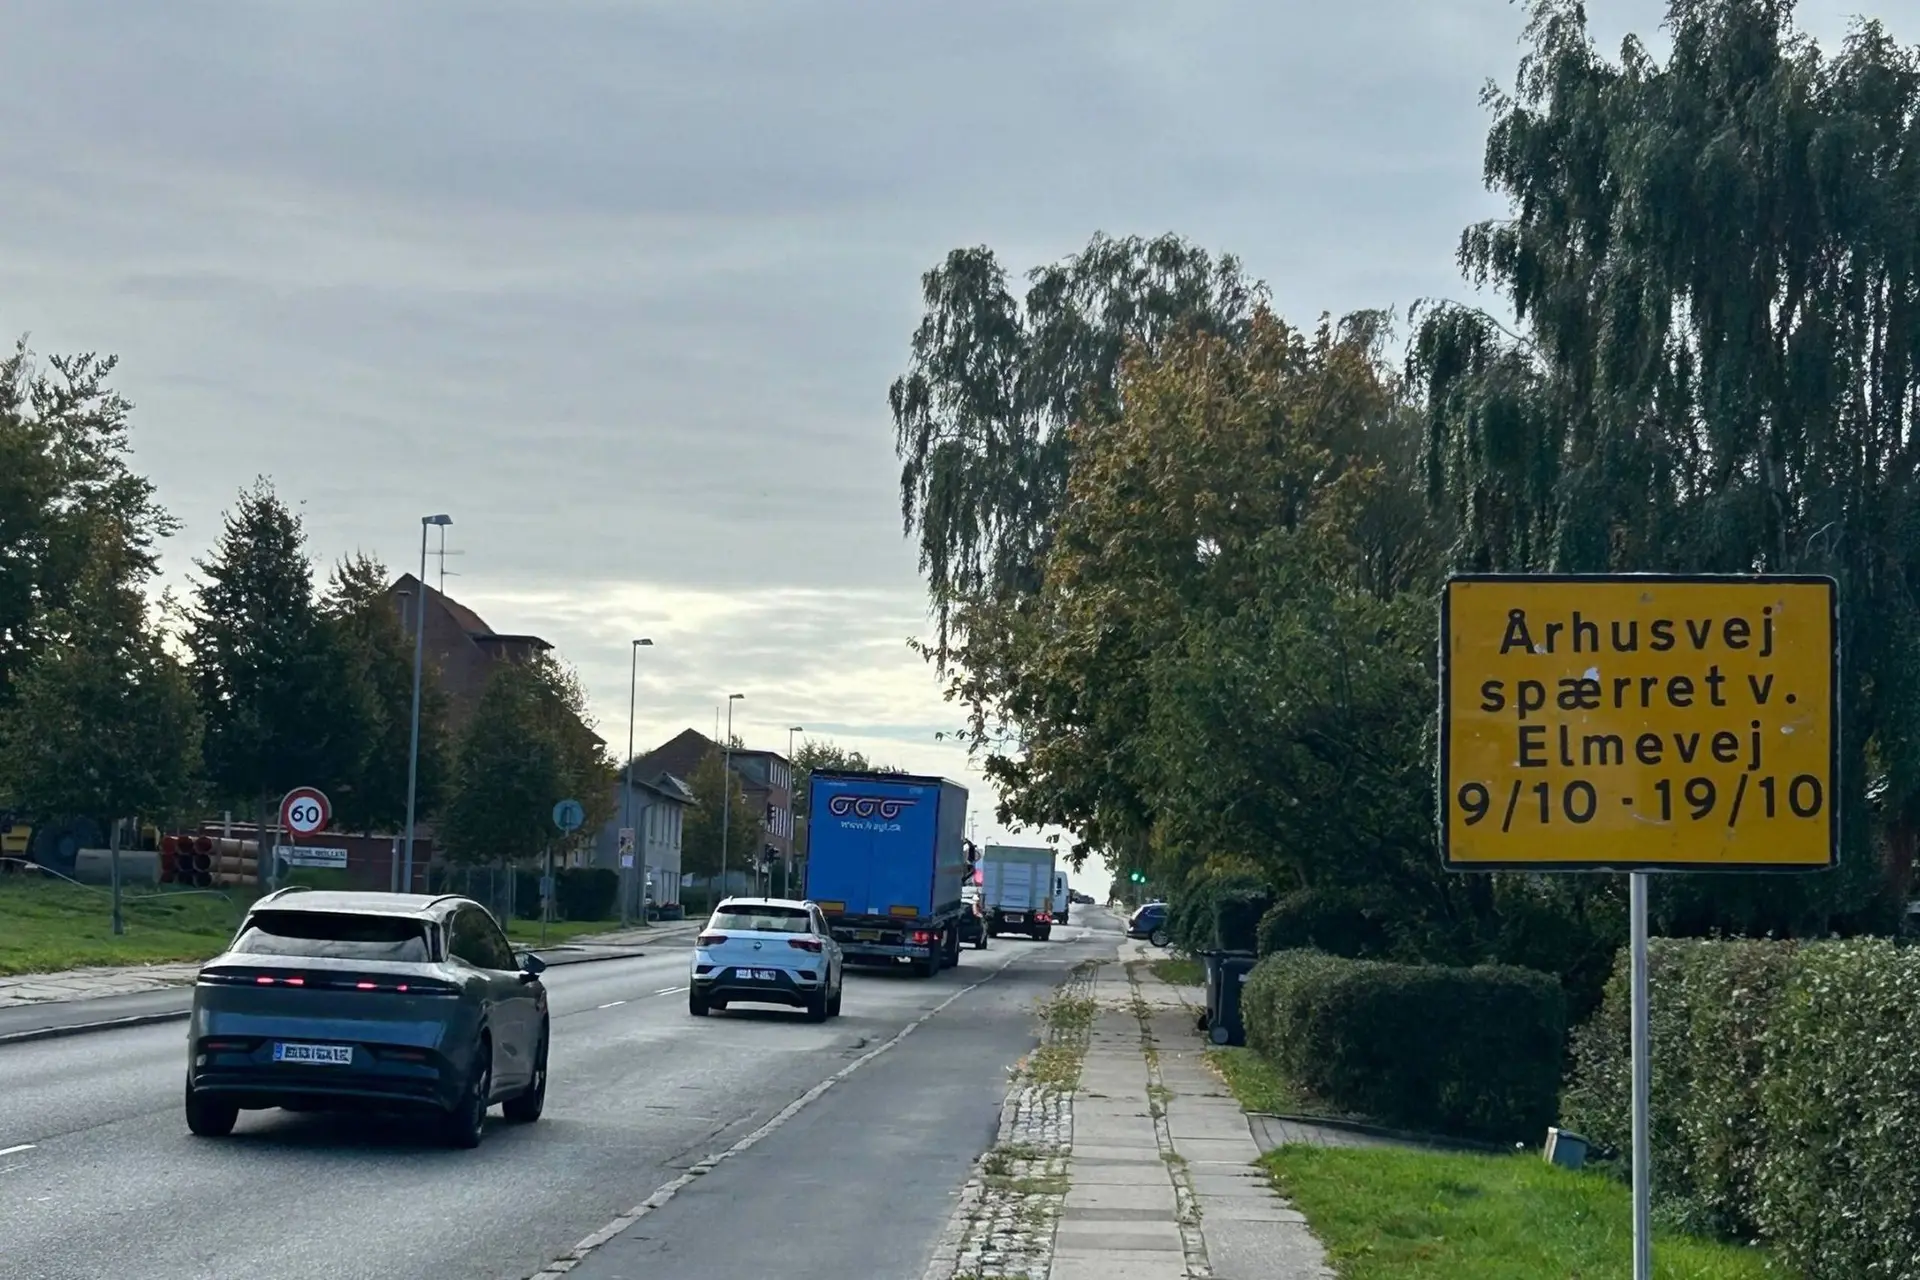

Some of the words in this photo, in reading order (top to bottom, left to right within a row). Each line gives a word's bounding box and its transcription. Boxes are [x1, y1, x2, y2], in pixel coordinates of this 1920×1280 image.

[1500, 606, 1774, 657] Århusvej
[1480, 666, 1726, 720] spærret
[1747, 674, 1797, 704] v.
[1518, 720, 1761, 771] Elmevej
[291, 805, 319, 823] 60
[1457, 779, 1598, 832] 9/10
[1654, 774, 1823, 828] 19/10
